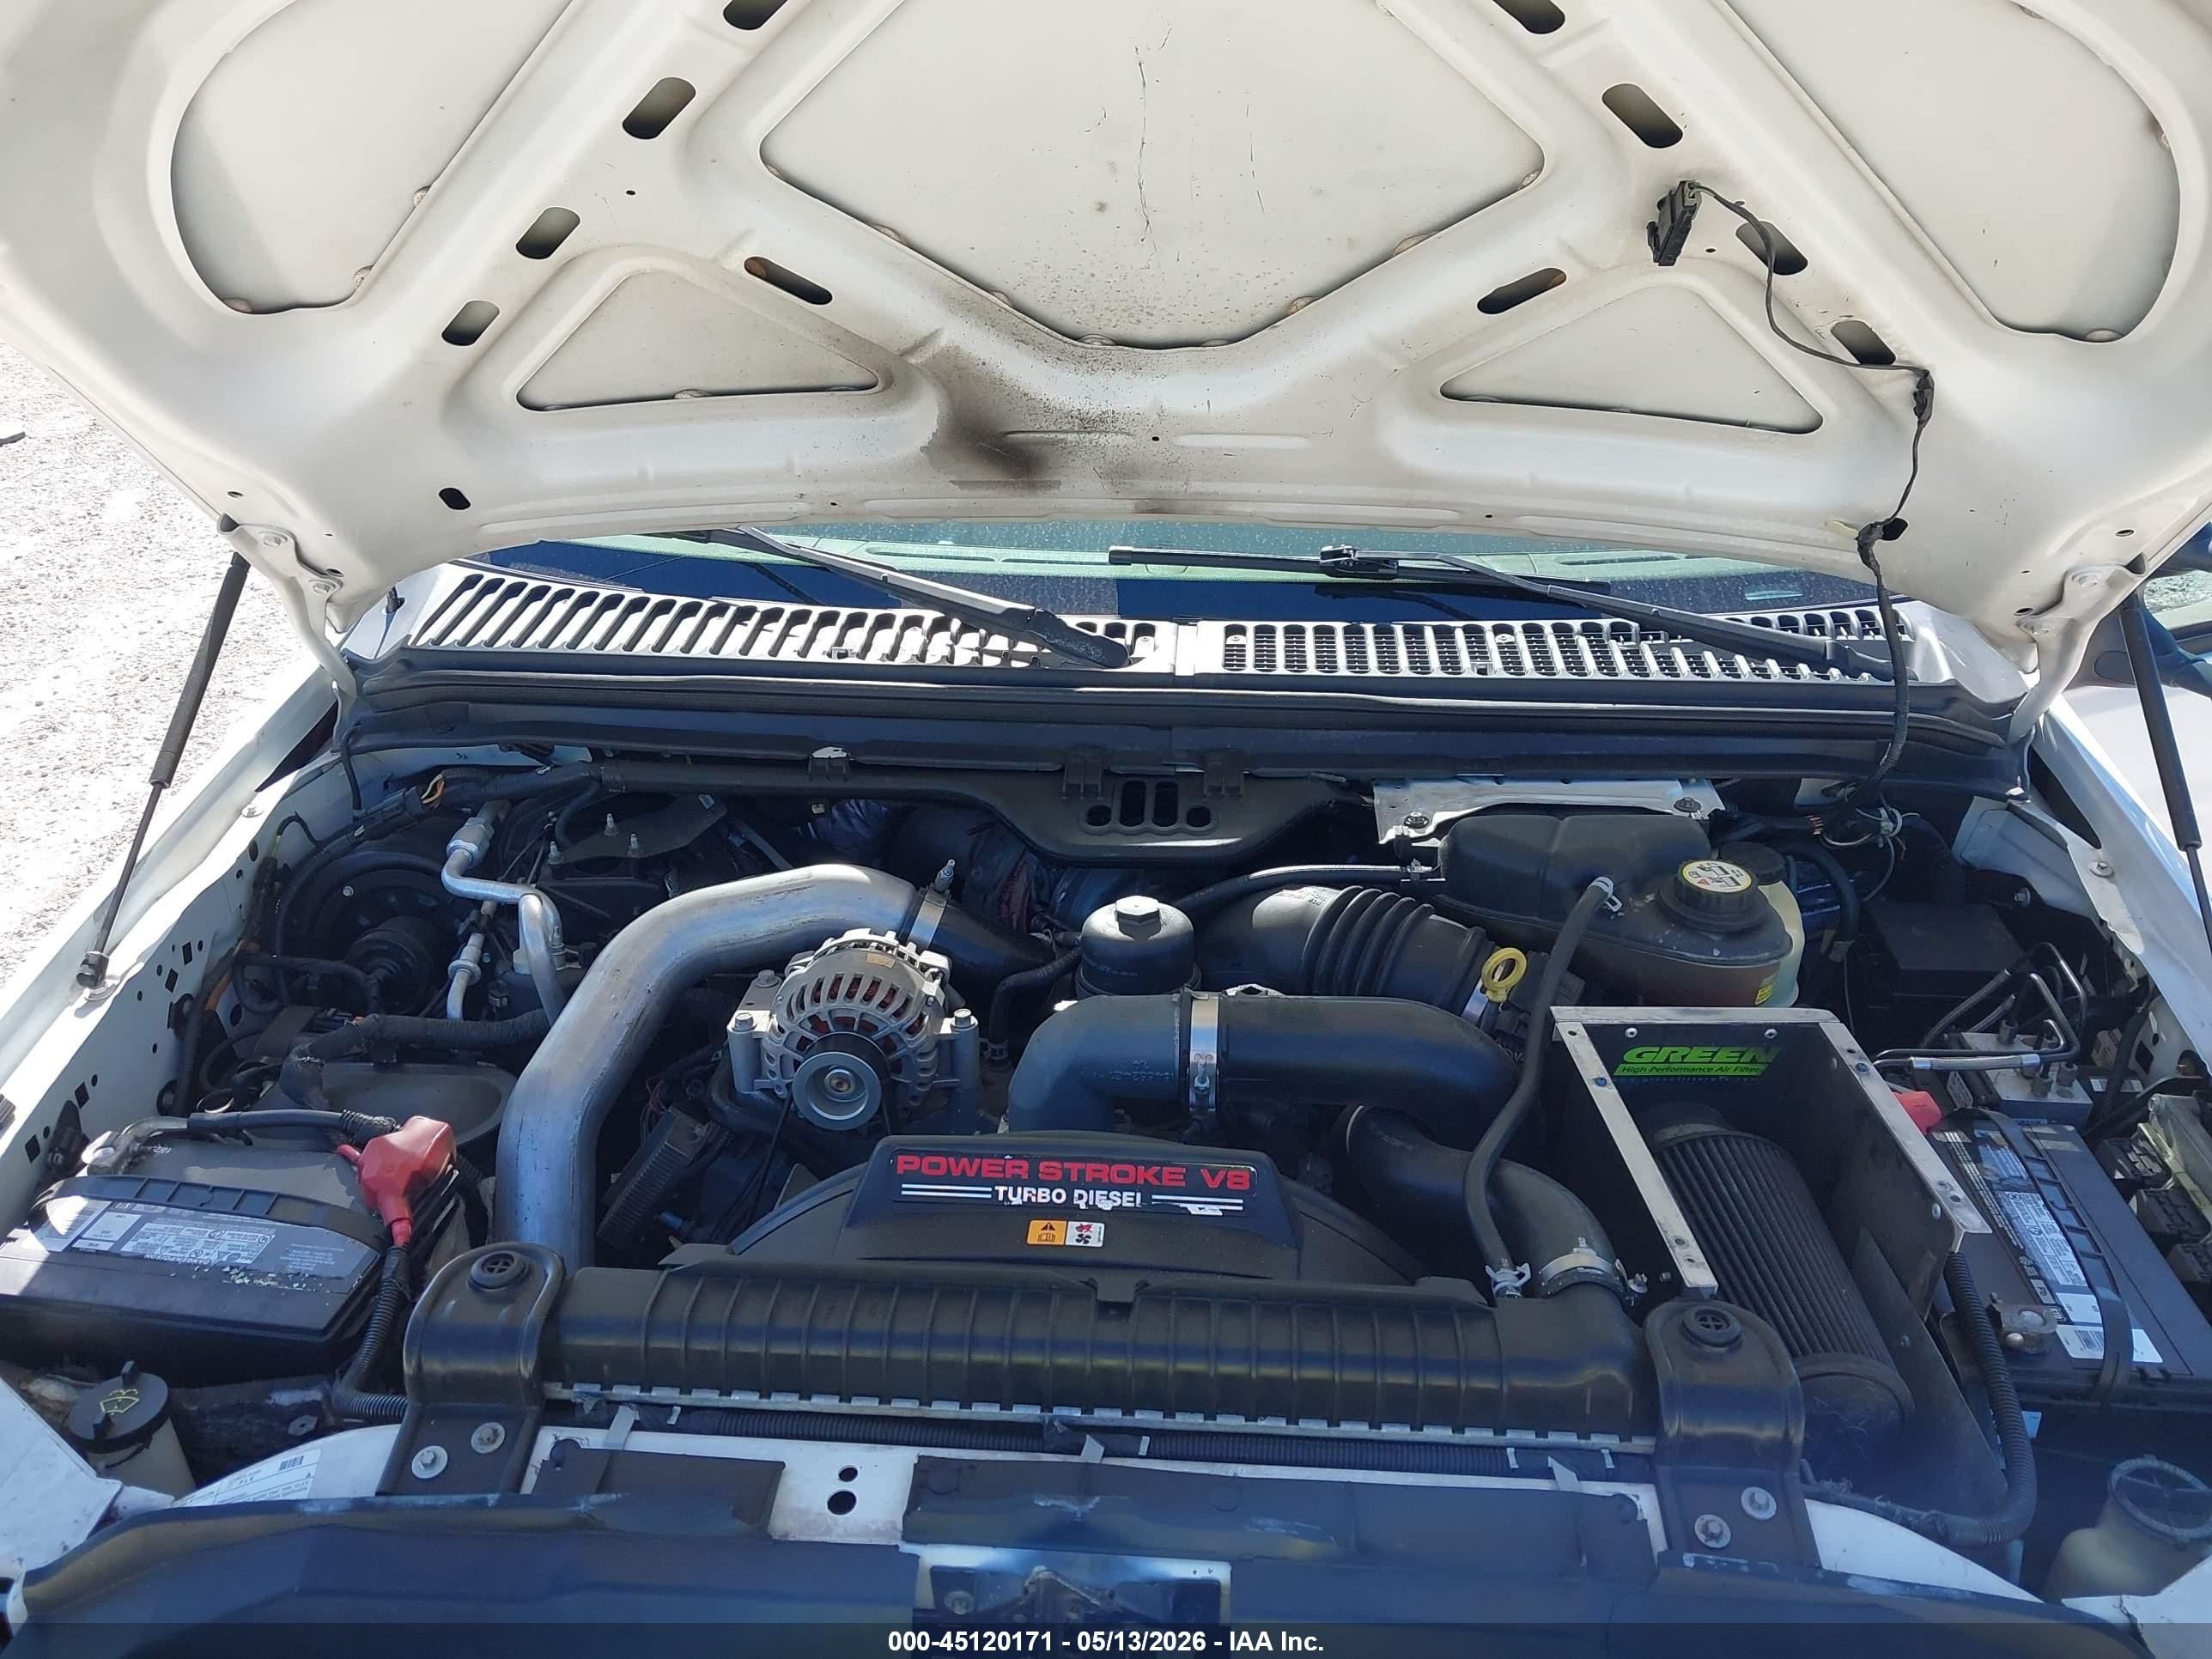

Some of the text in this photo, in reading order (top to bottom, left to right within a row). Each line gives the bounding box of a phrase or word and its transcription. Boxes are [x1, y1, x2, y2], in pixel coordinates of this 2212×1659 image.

[1623, 1046, 1781, 1063] GREEN
[1621, 1066, 1647, 1074] High
[896, 1155, 1251, 1191] POWER STROKE V8
[994, 1185, 1143, 1208] TURBO DIESEL
